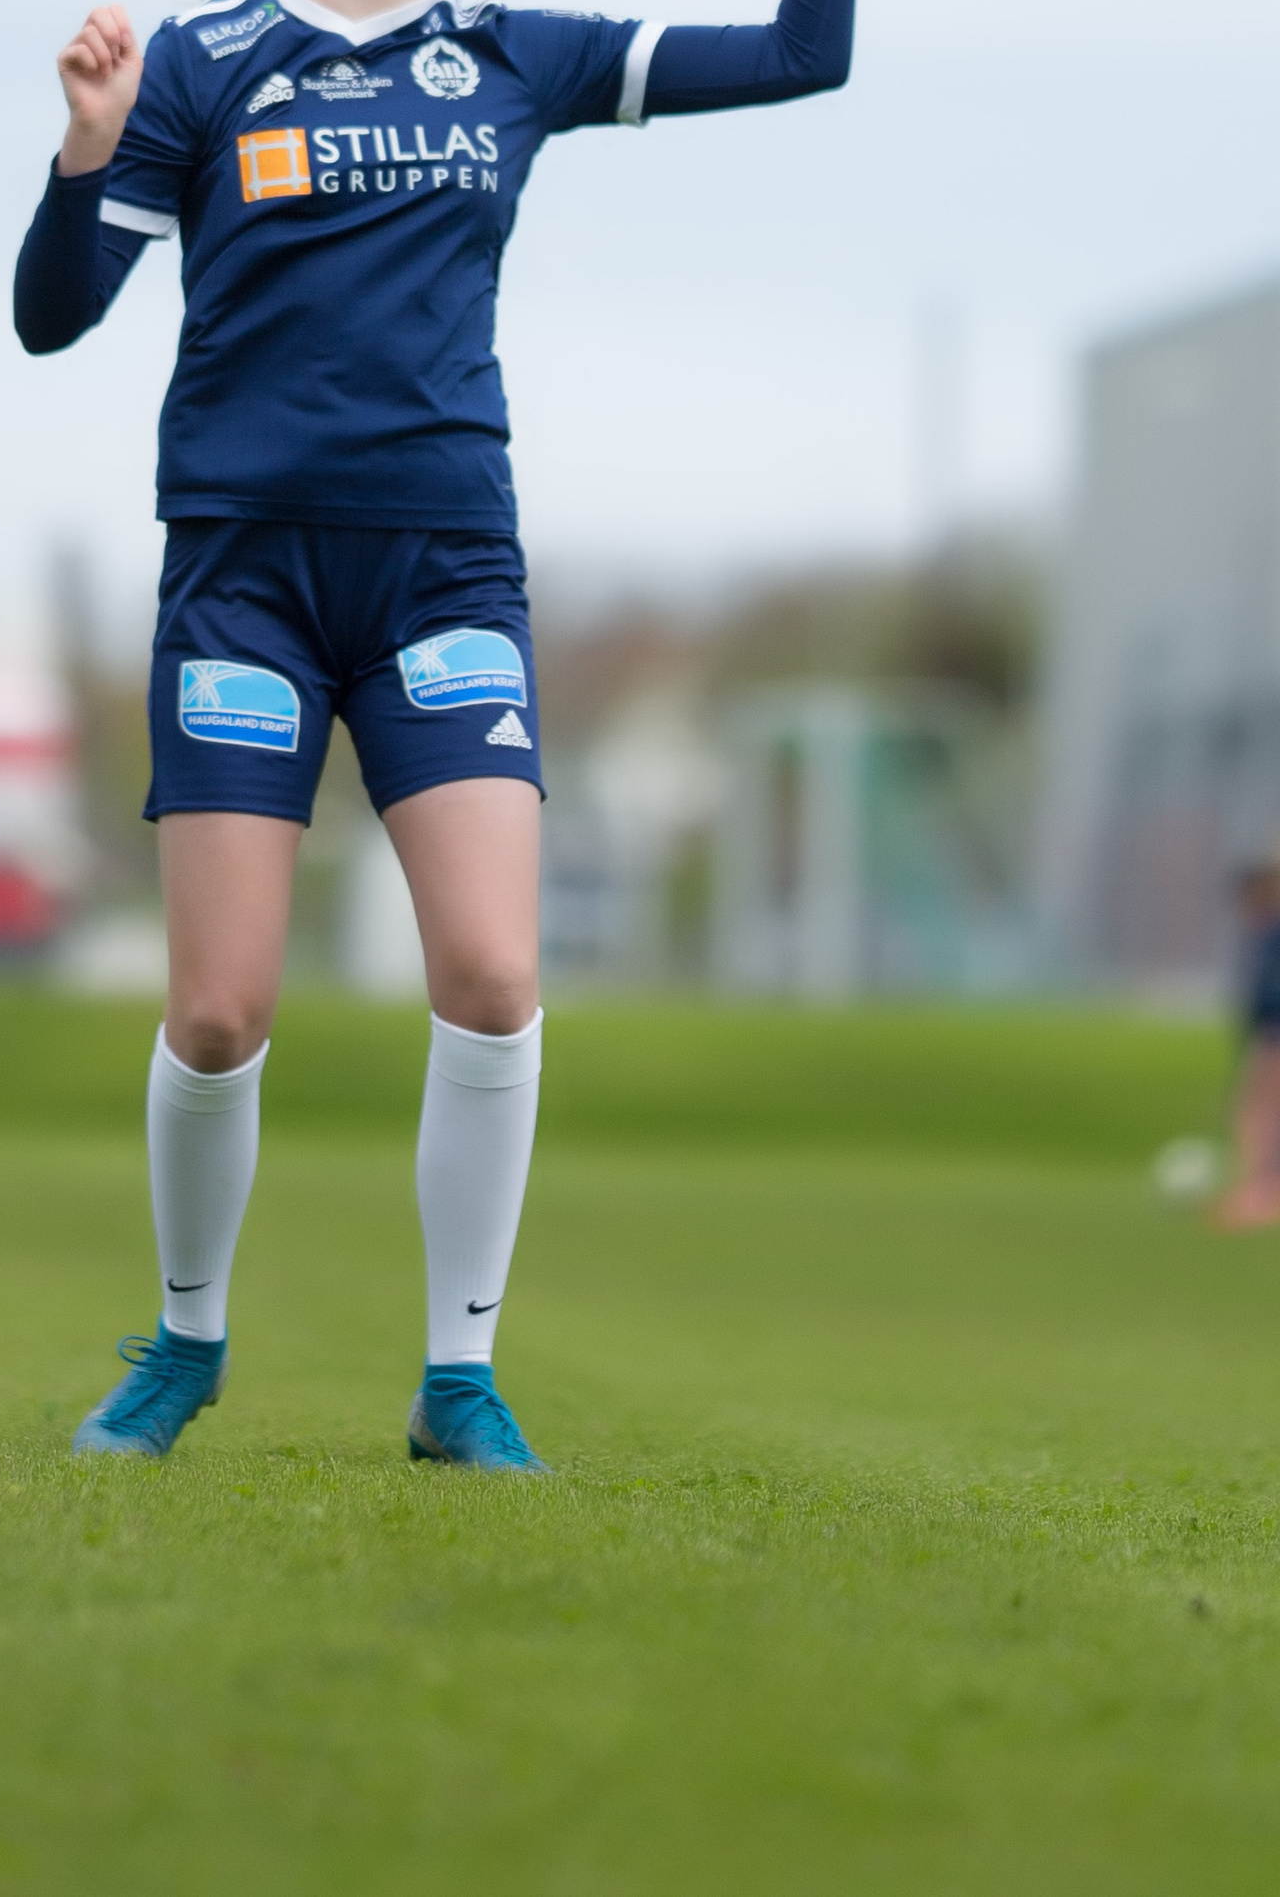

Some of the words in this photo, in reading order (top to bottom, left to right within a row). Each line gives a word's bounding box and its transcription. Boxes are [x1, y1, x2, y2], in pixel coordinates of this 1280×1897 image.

[351, 79, 361, 89] &
[321, 89, 378, 102] Sparebank
[312, 123, 500, 164] STILLAS
[319, 166, 499, 194] GRUPPEN
[417, 677, 492, 699] HAUGALAND
[187, 714, 259, 729] HAUGALAND
[260, 720, 294, 734] KRAFT
